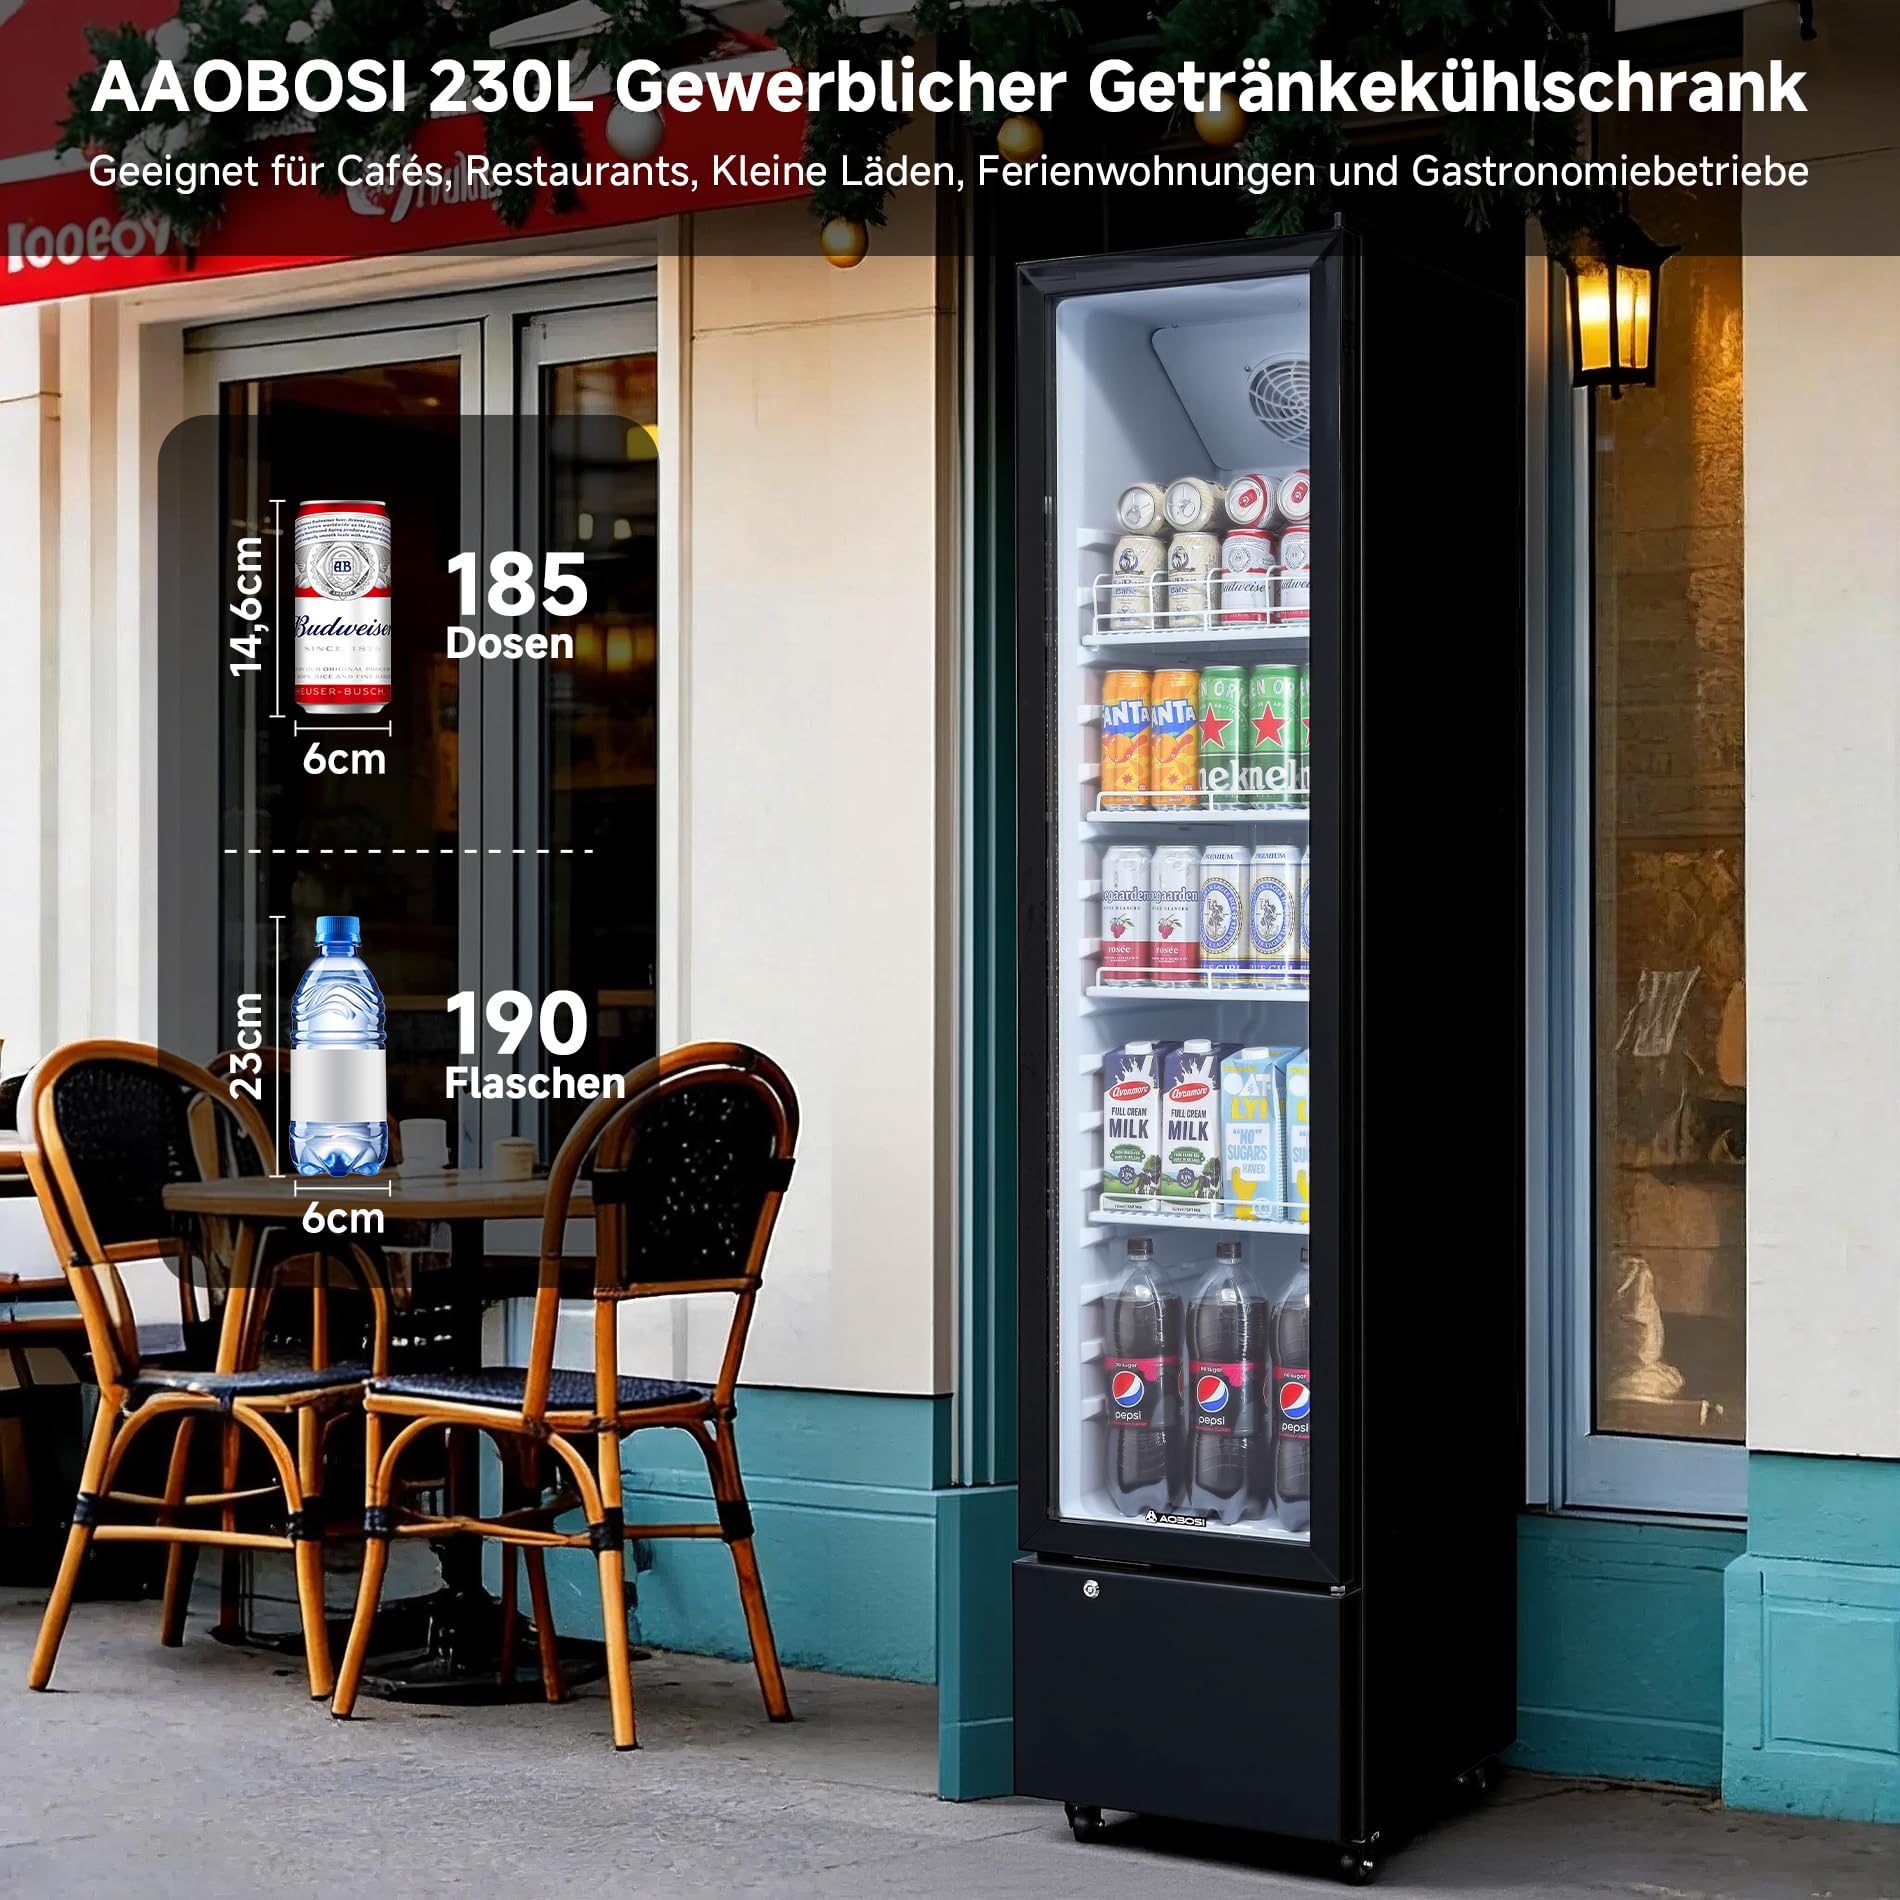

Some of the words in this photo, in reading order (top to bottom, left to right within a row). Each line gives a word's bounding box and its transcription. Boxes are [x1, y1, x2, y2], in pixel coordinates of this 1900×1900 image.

[1112, 1107, 1125, 1116] FULL
[1127, 1108, 1147, 1117] CREAM
[1171, 1109, 1185, 1118] FULL
[1187, 1109, 1206, 1118] CREAM
[1109, 1119, 1149, 1139] MILK
[1168, 1120, 1208, 1141] MILK
[1227, 1145, 1268, 1160] SUGARS
[1115, 1411, 1142, 1421] pepsi
[1198, 1415, 1225, 1426] pepsi
[1282, 1422, 1309, 1434] pepsi
